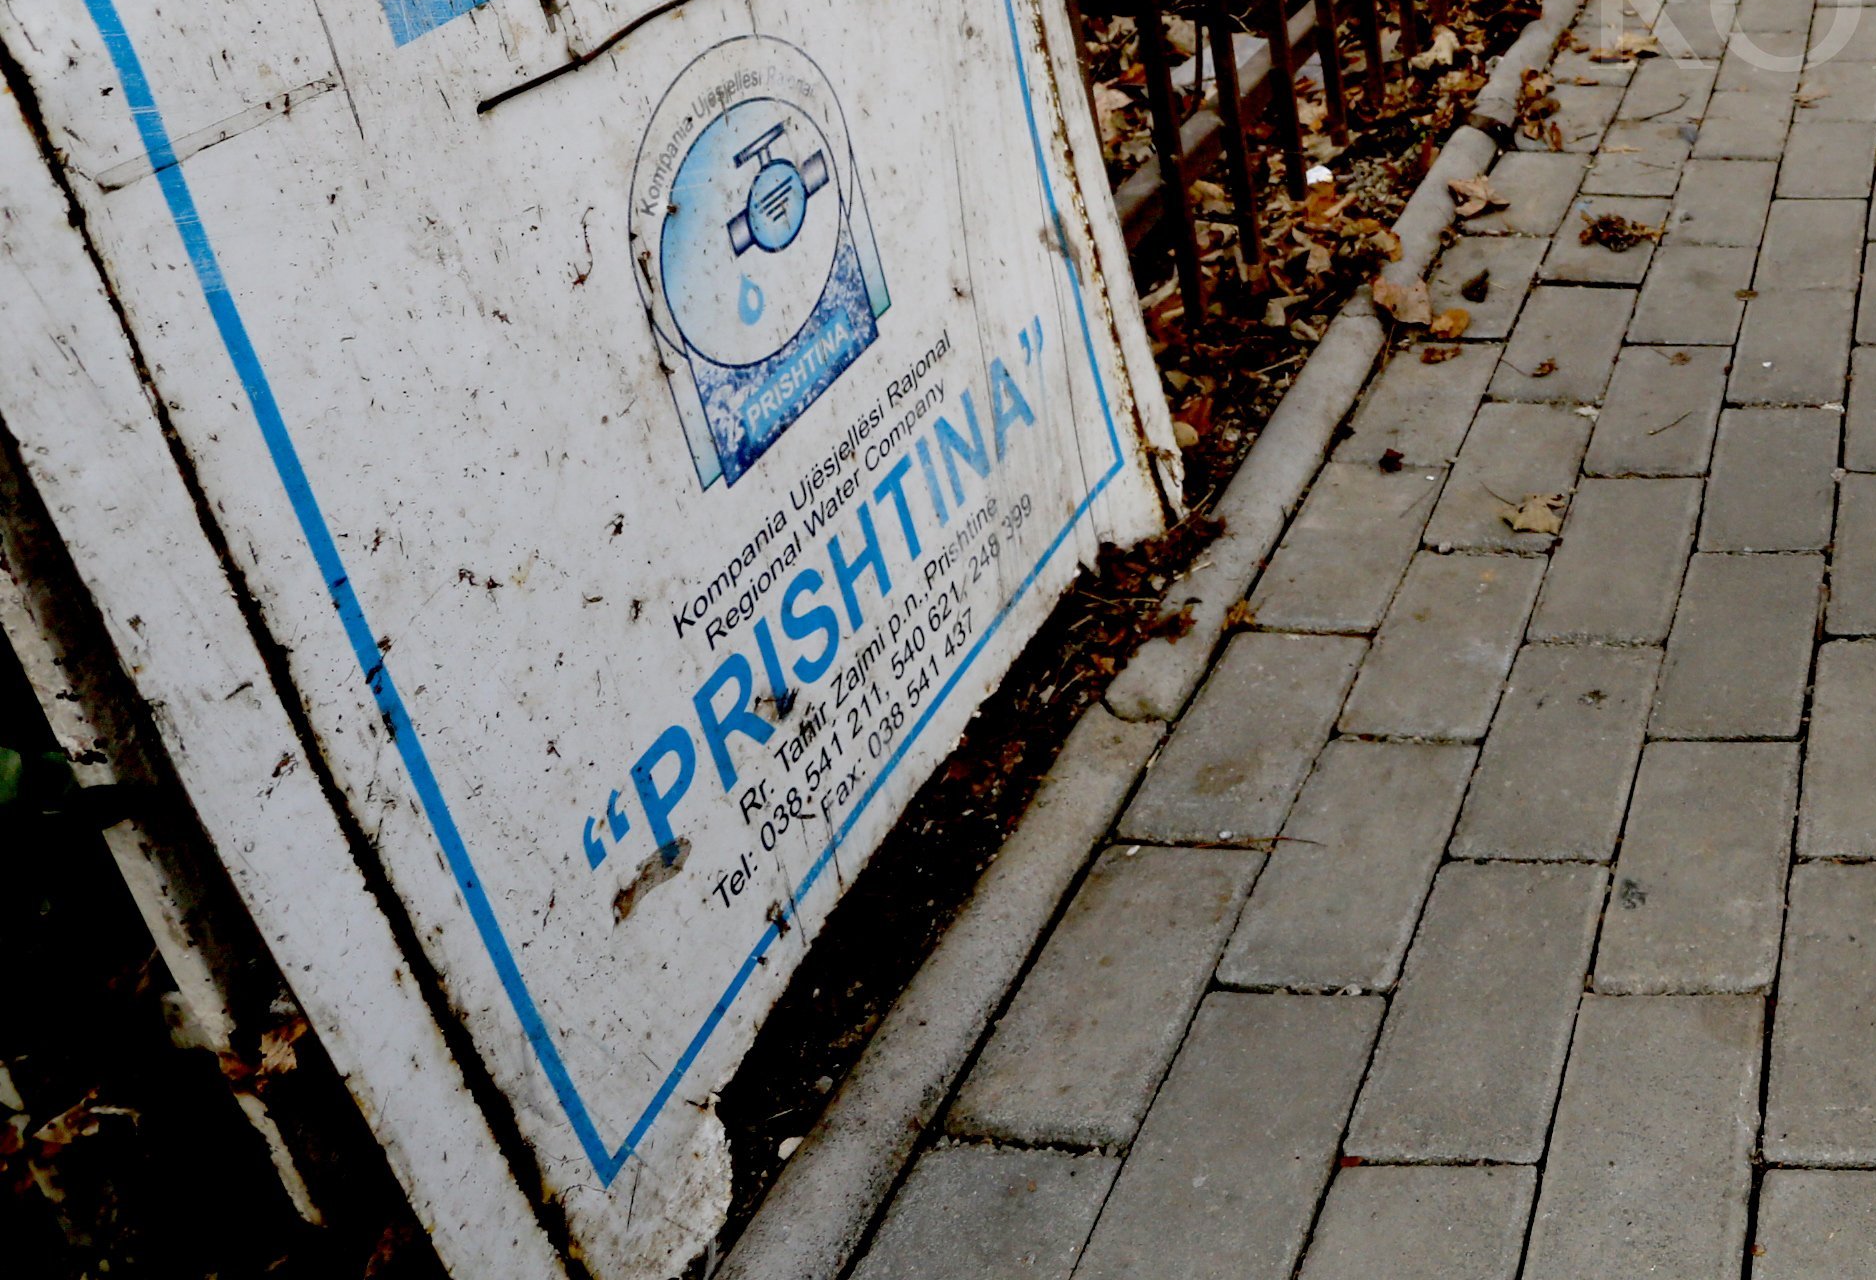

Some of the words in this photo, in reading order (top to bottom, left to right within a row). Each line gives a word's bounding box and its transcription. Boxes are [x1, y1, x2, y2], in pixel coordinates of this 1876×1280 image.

[672, 510, 788, 638] Kompania
[789, 398, 885, 511] Ujësjellësi
[886, 329, 951, 409] Rajonal
[745, 322, 850, 433] PRISHTINA
[704, 534, 803, 651] Regional
[803, 469, 861, 538] Water
[864, 378, 946, 472] Company
[713, 852, 758, 910] Tel:
[760, 787, 803, 852] 038
[805, 731, 844, 792] 541
[891, 625, 926, 681] 540
[968, 532, 1000, 584] 248
[738, 778, 776, 826] Rr.
[830, 626, 886, 709] Zajmi
[820, 758, 866, 819] Fax:
[868, 702, 905, 760] 038
[906, 653, 941, 710] 541
[945, 606, 973, 659] 437
